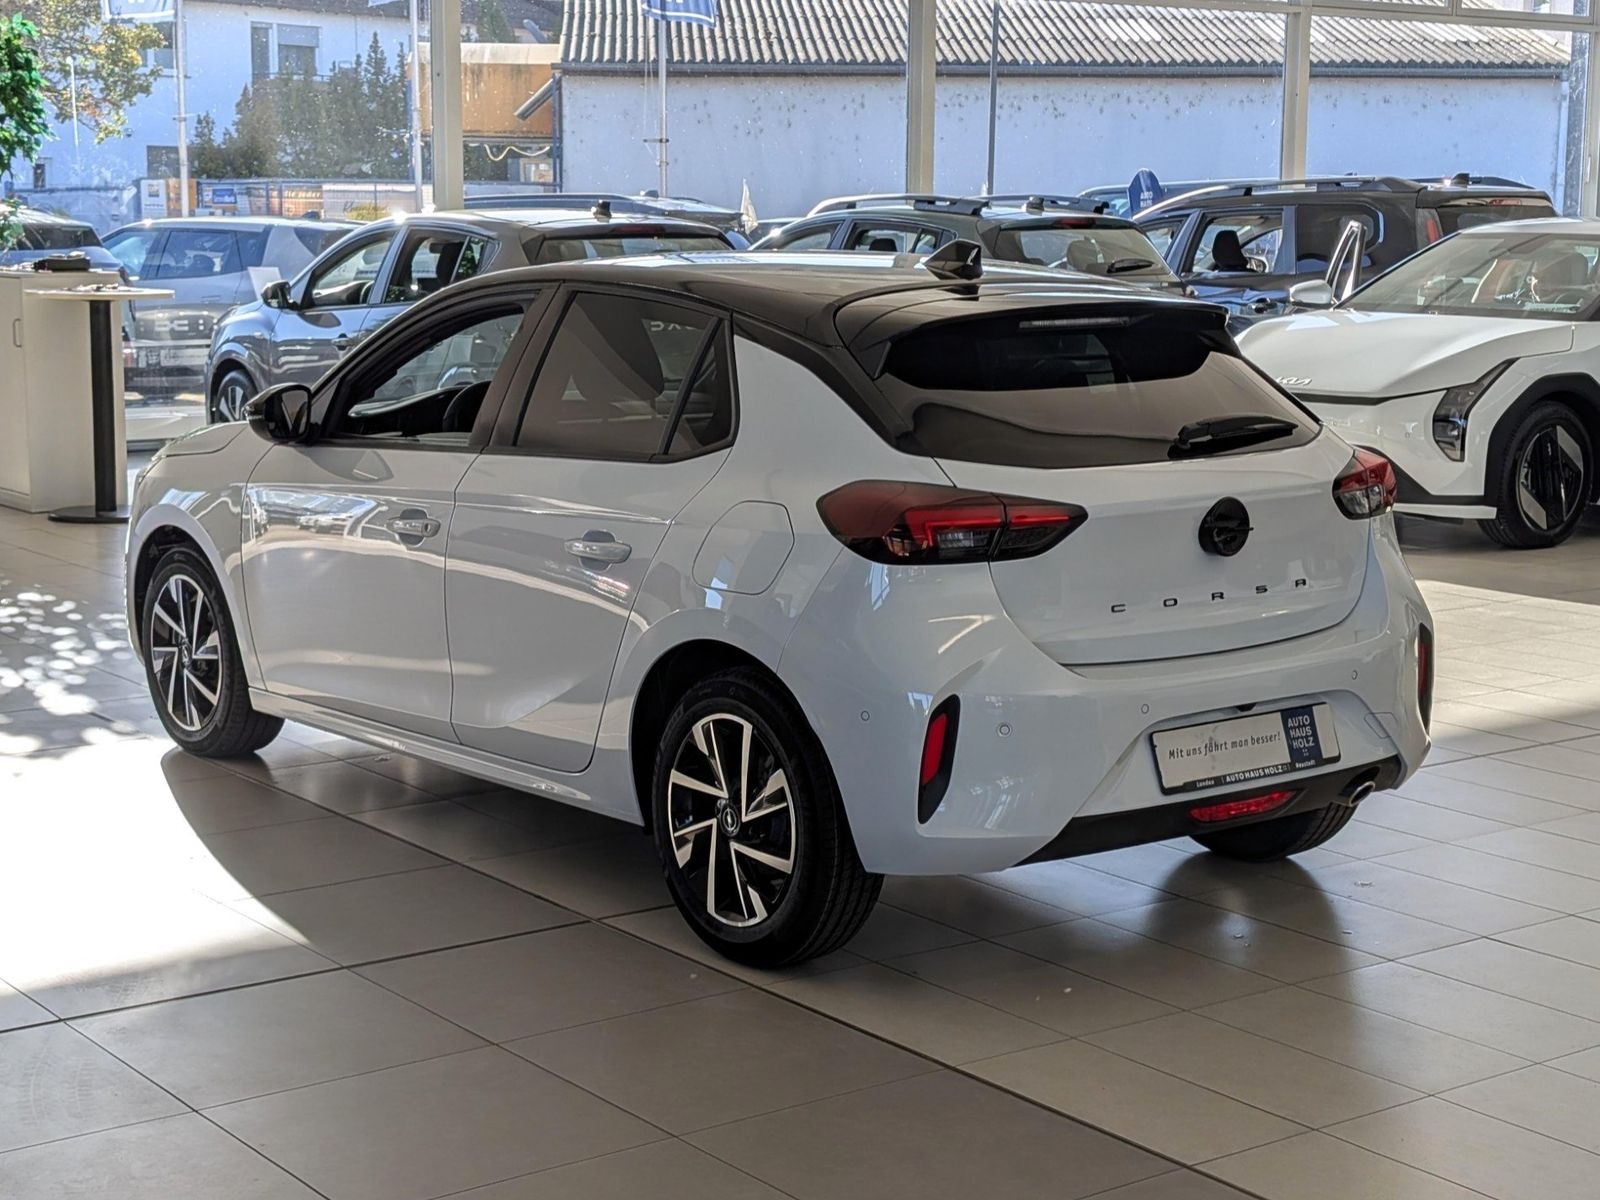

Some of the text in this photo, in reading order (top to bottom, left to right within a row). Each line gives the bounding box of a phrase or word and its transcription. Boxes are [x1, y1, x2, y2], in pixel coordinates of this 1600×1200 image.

[1110, 578, 1307, 613] CORSA
[1287, 715, 1310, 728] AUTO
[1290, 726, 1312, 739] HAUS
[1168, 748, 1184, 760] Mit
[1186, 747, 1202, 757] uns
[1231, 738, 1249, 749] man
[1250, 732, 1281, 746] besser!
[1292, 736, 1315, 749] HOLZ
[1264, 765, 1283, 775] HOLZ
